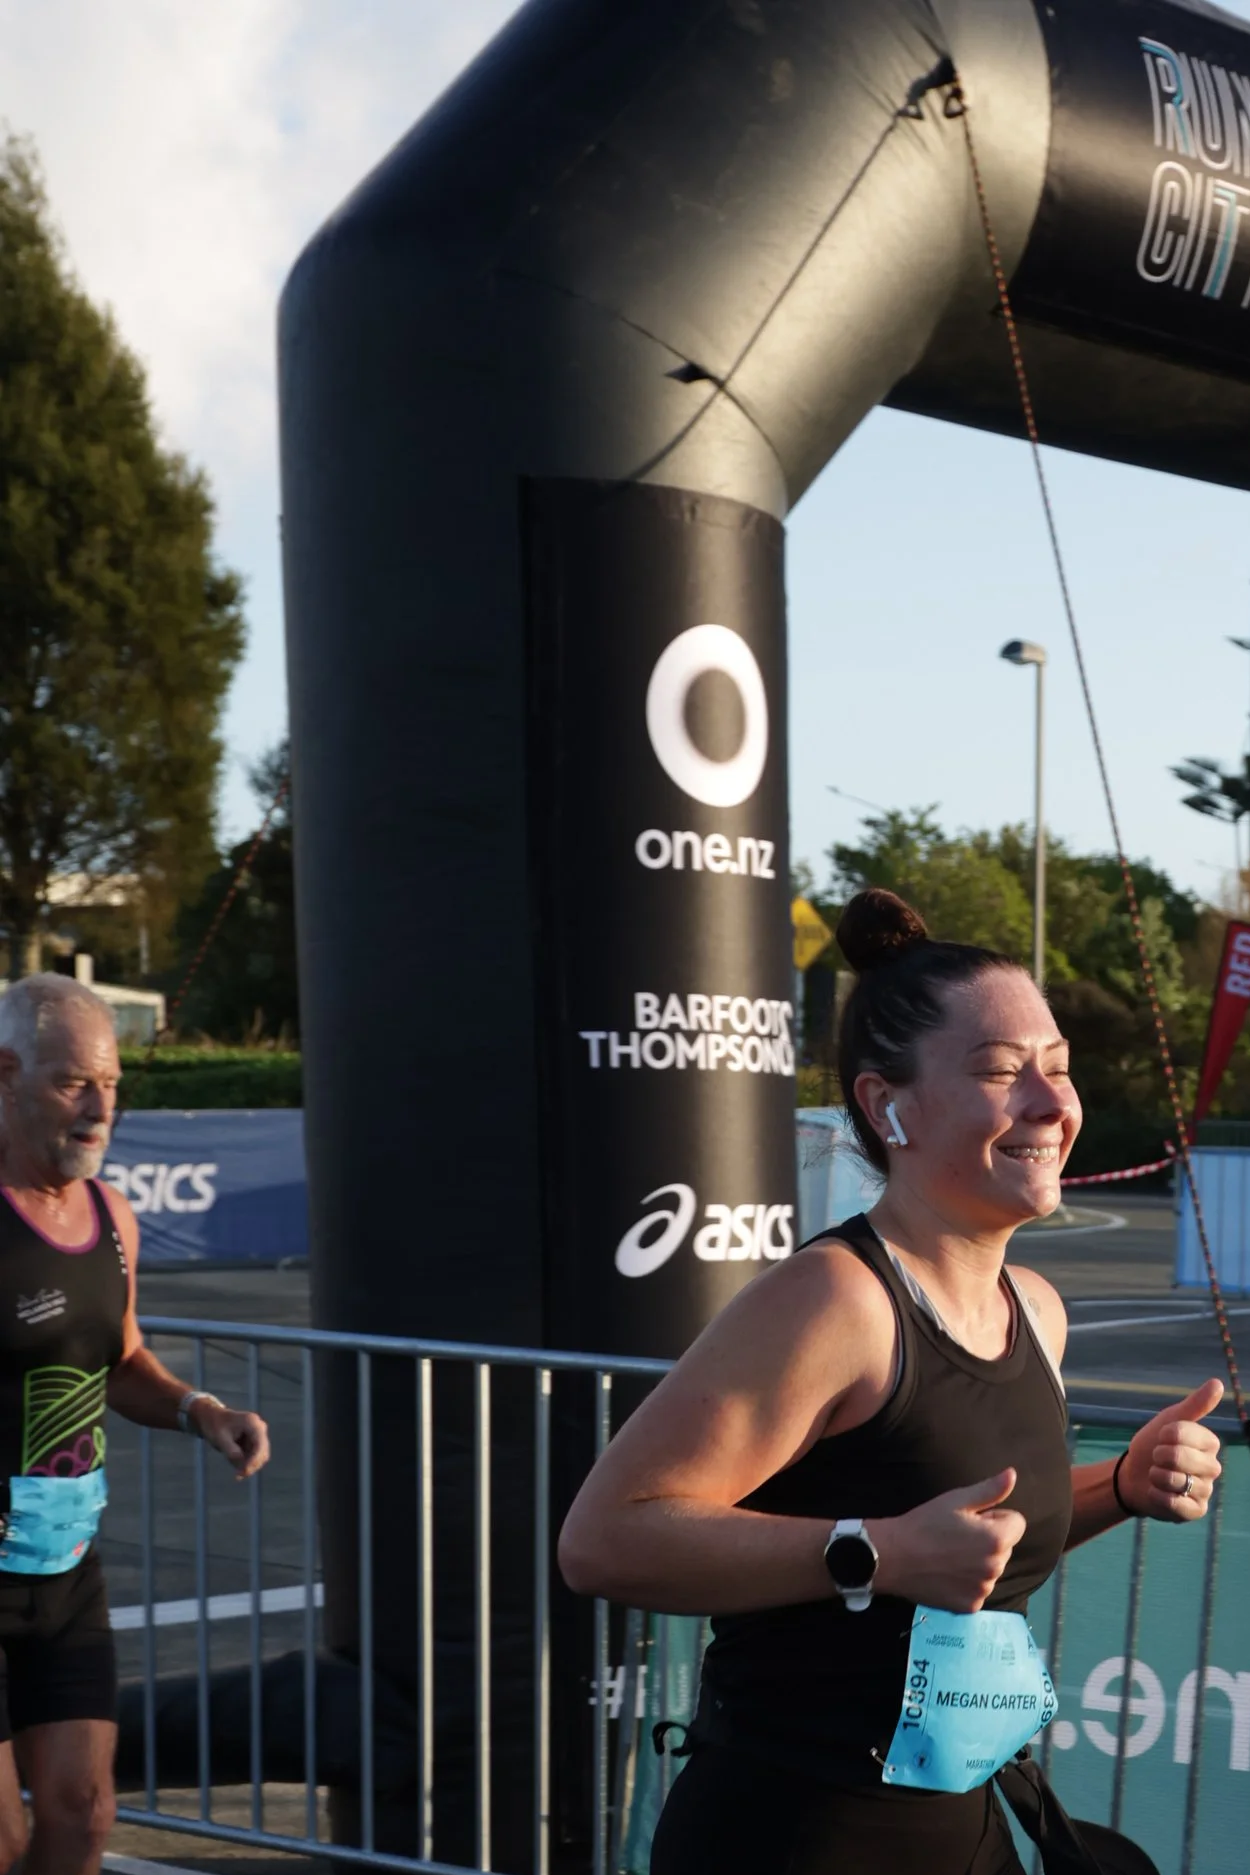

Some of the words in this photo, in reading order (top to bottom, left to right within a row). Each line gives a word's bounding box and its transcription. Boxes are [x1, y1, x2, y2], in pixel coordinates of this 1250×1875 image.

[635, 827, 775, 880] one.nz
[577, 1030, 784, 1075] THOMPSON
[902, 1658, 931, 1731] 10394
[936, 1690, 989, 1711] MEGAN
[991, 1693, 1038, 1711] CARTER
